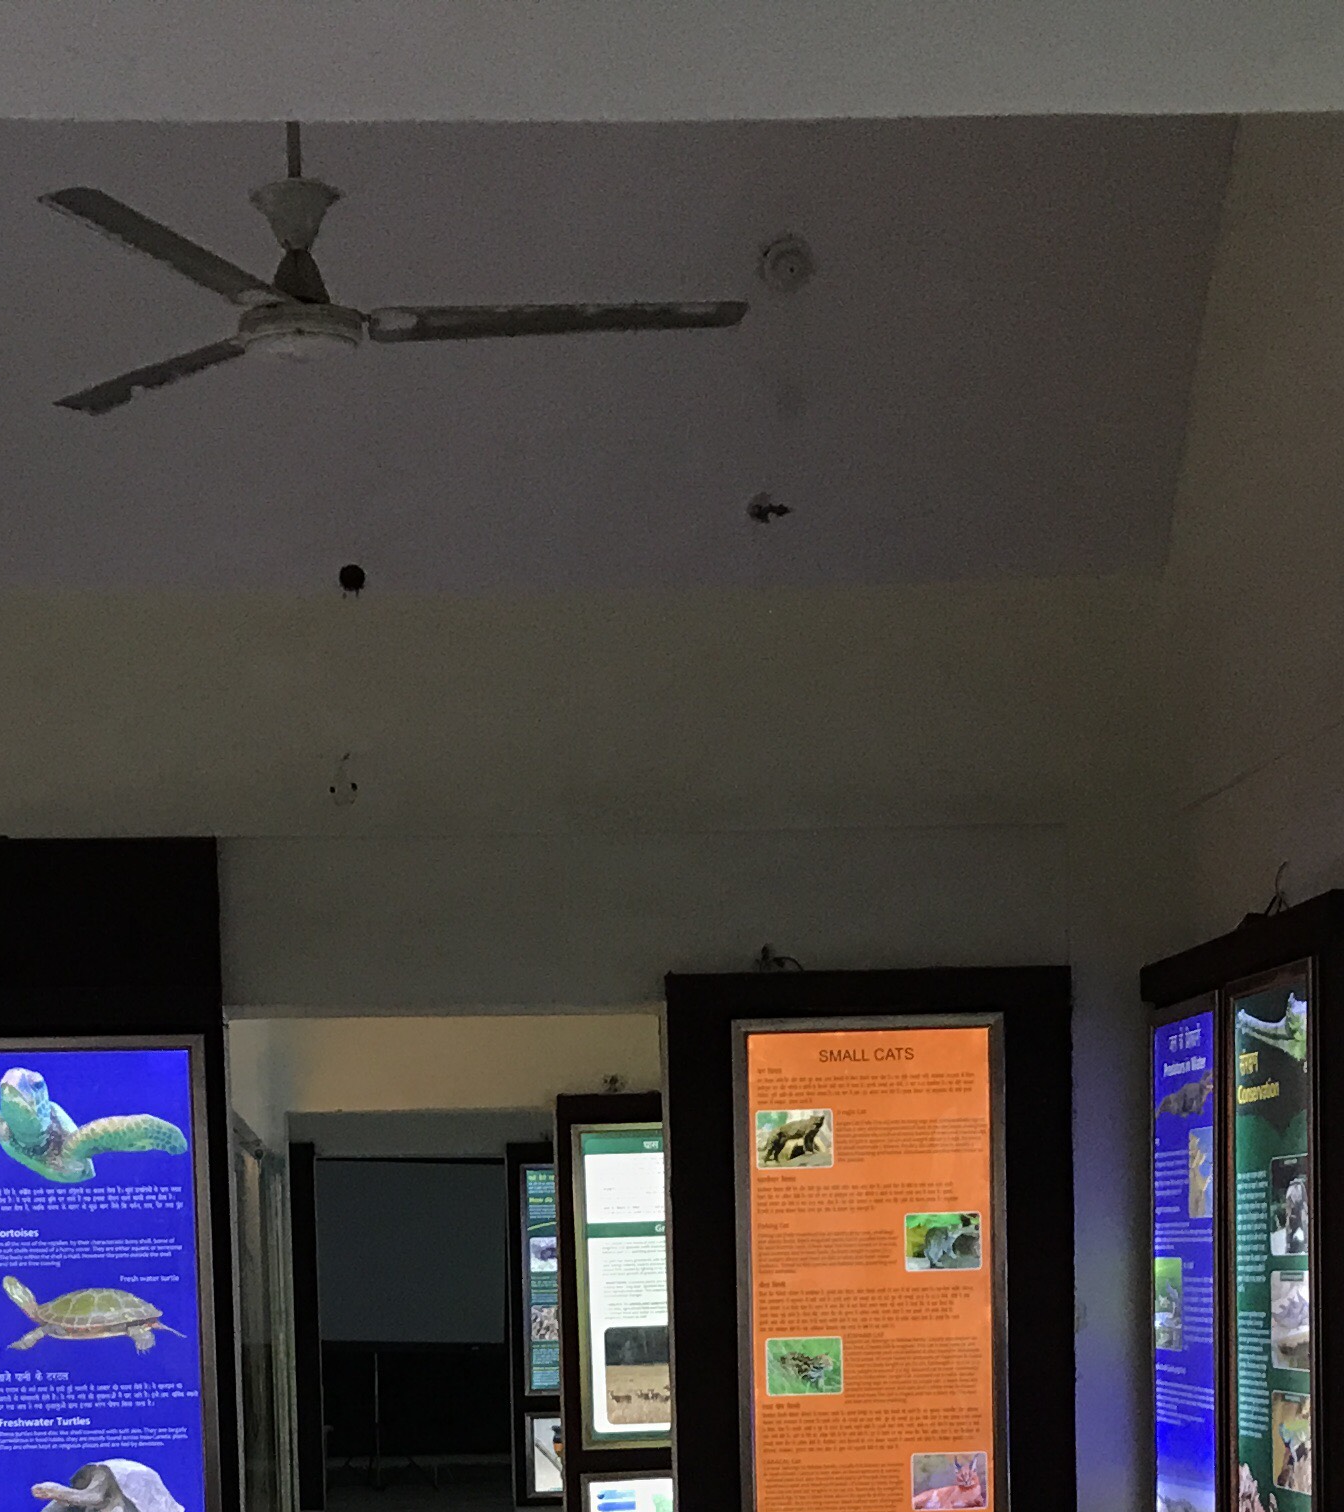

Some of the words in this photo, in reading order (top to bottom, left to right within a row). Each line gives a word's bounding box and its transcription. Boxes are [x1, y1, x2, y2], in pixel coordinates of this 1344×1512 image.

[818, 1048, 868, 1063] SMALL
[873, 1047, 915, 1061] CATS
[56, 1416, 91, 1426] Turtles
